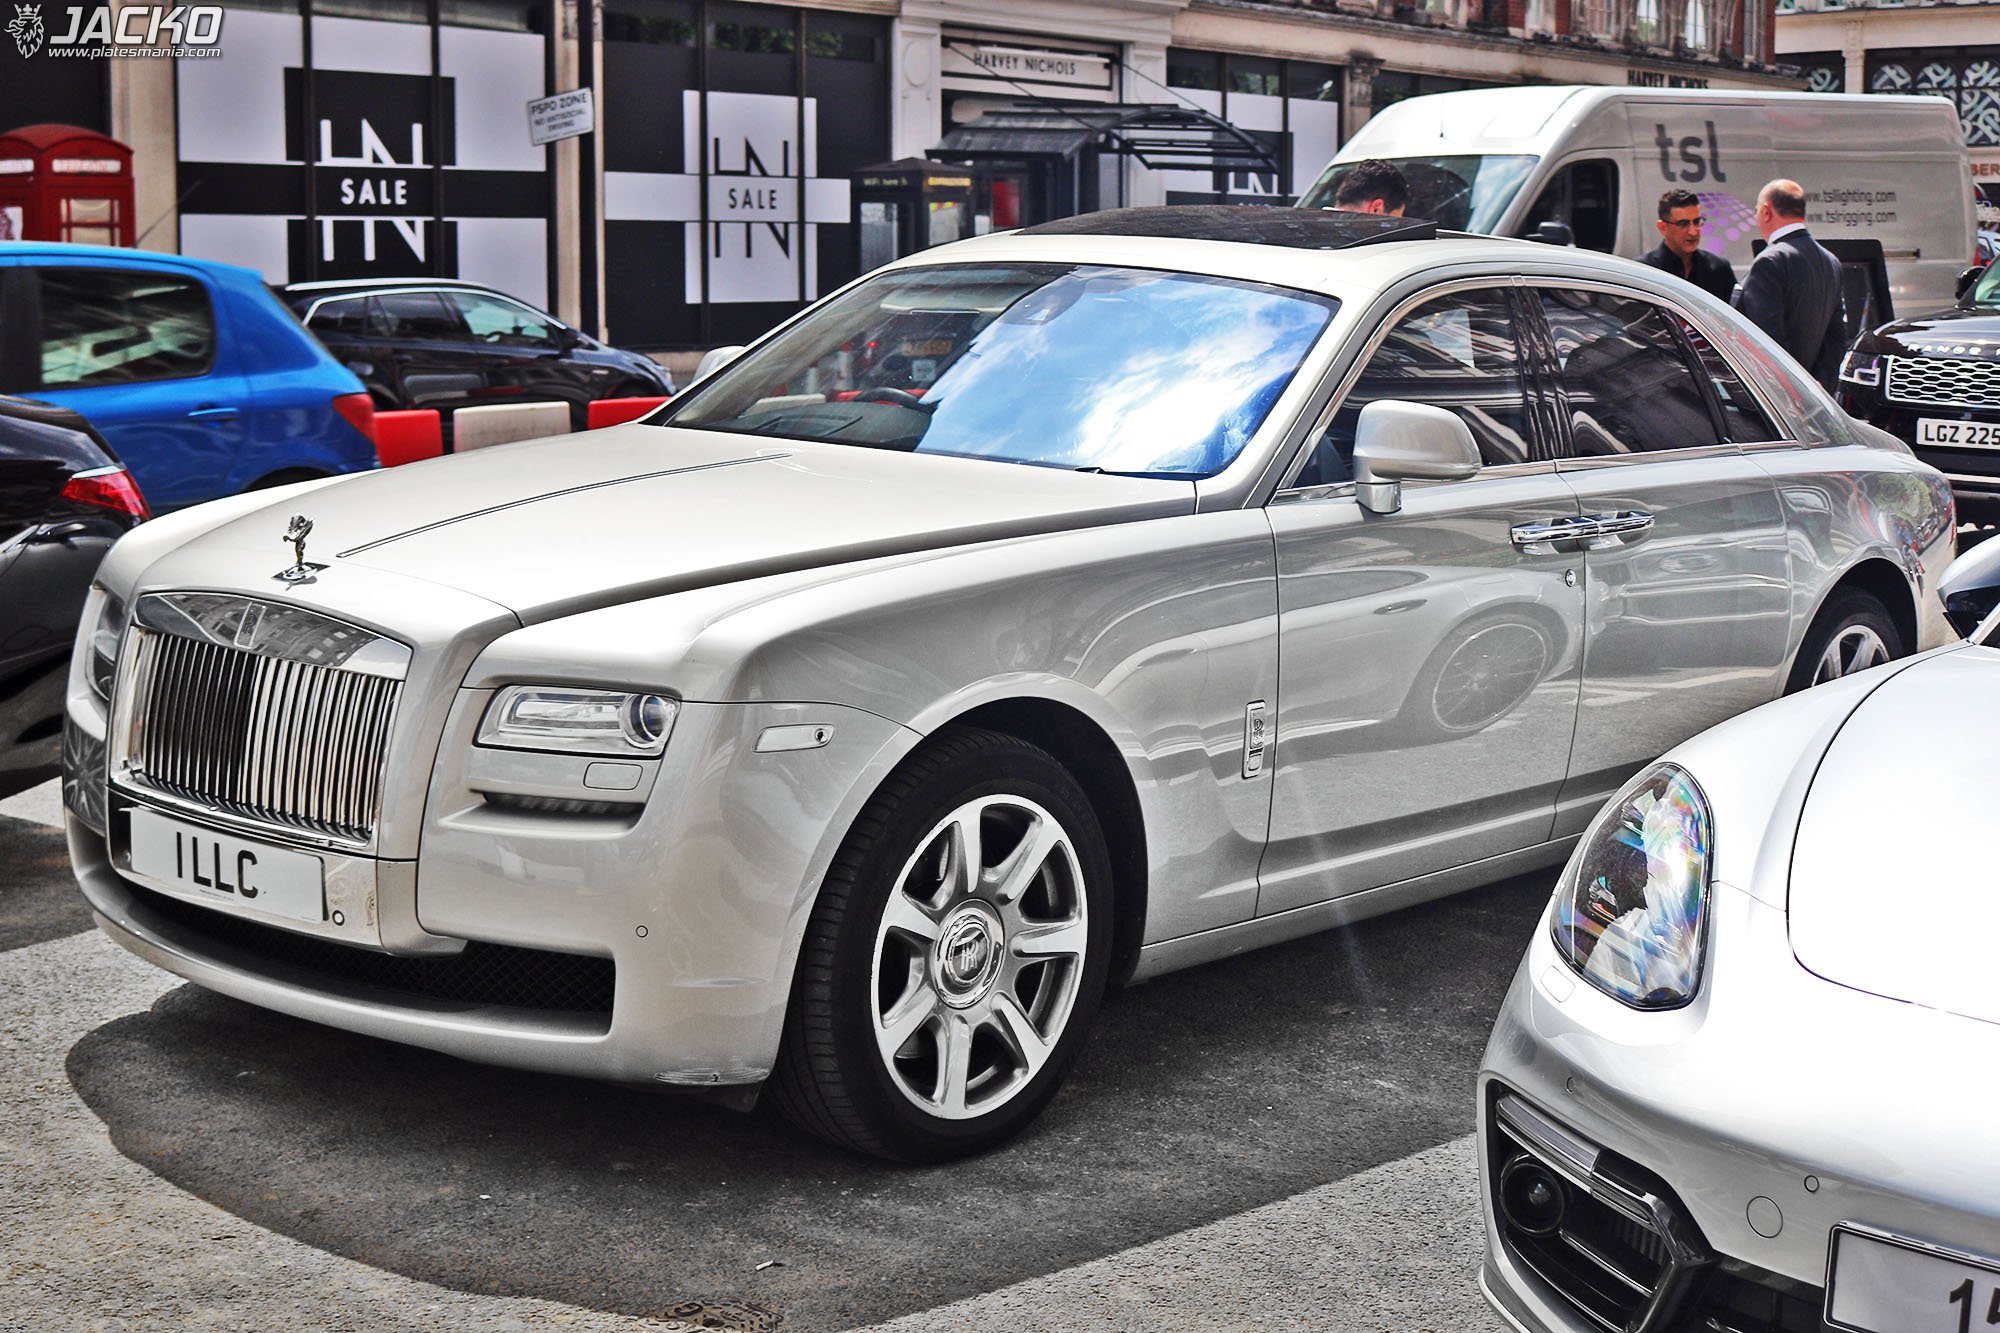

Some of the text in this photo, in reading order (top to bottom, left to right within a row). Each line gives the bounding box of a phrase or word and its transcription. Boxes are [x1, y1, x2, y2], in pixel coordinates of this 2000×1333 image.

[974, 52, 1076, 76] HARVEY NICHOLS
[1627, 69, 1665, 88] HARVEY
[559, 92, 588, 109] ZONE
[1655, 120, 1727, 183] tsl
[340, 177, 408, 206] SALE
[728, 187, 778, 210] SALE
[1907, 343, 1982, 356] RANGE
[1924, 424, 1960, 443] LGZ
